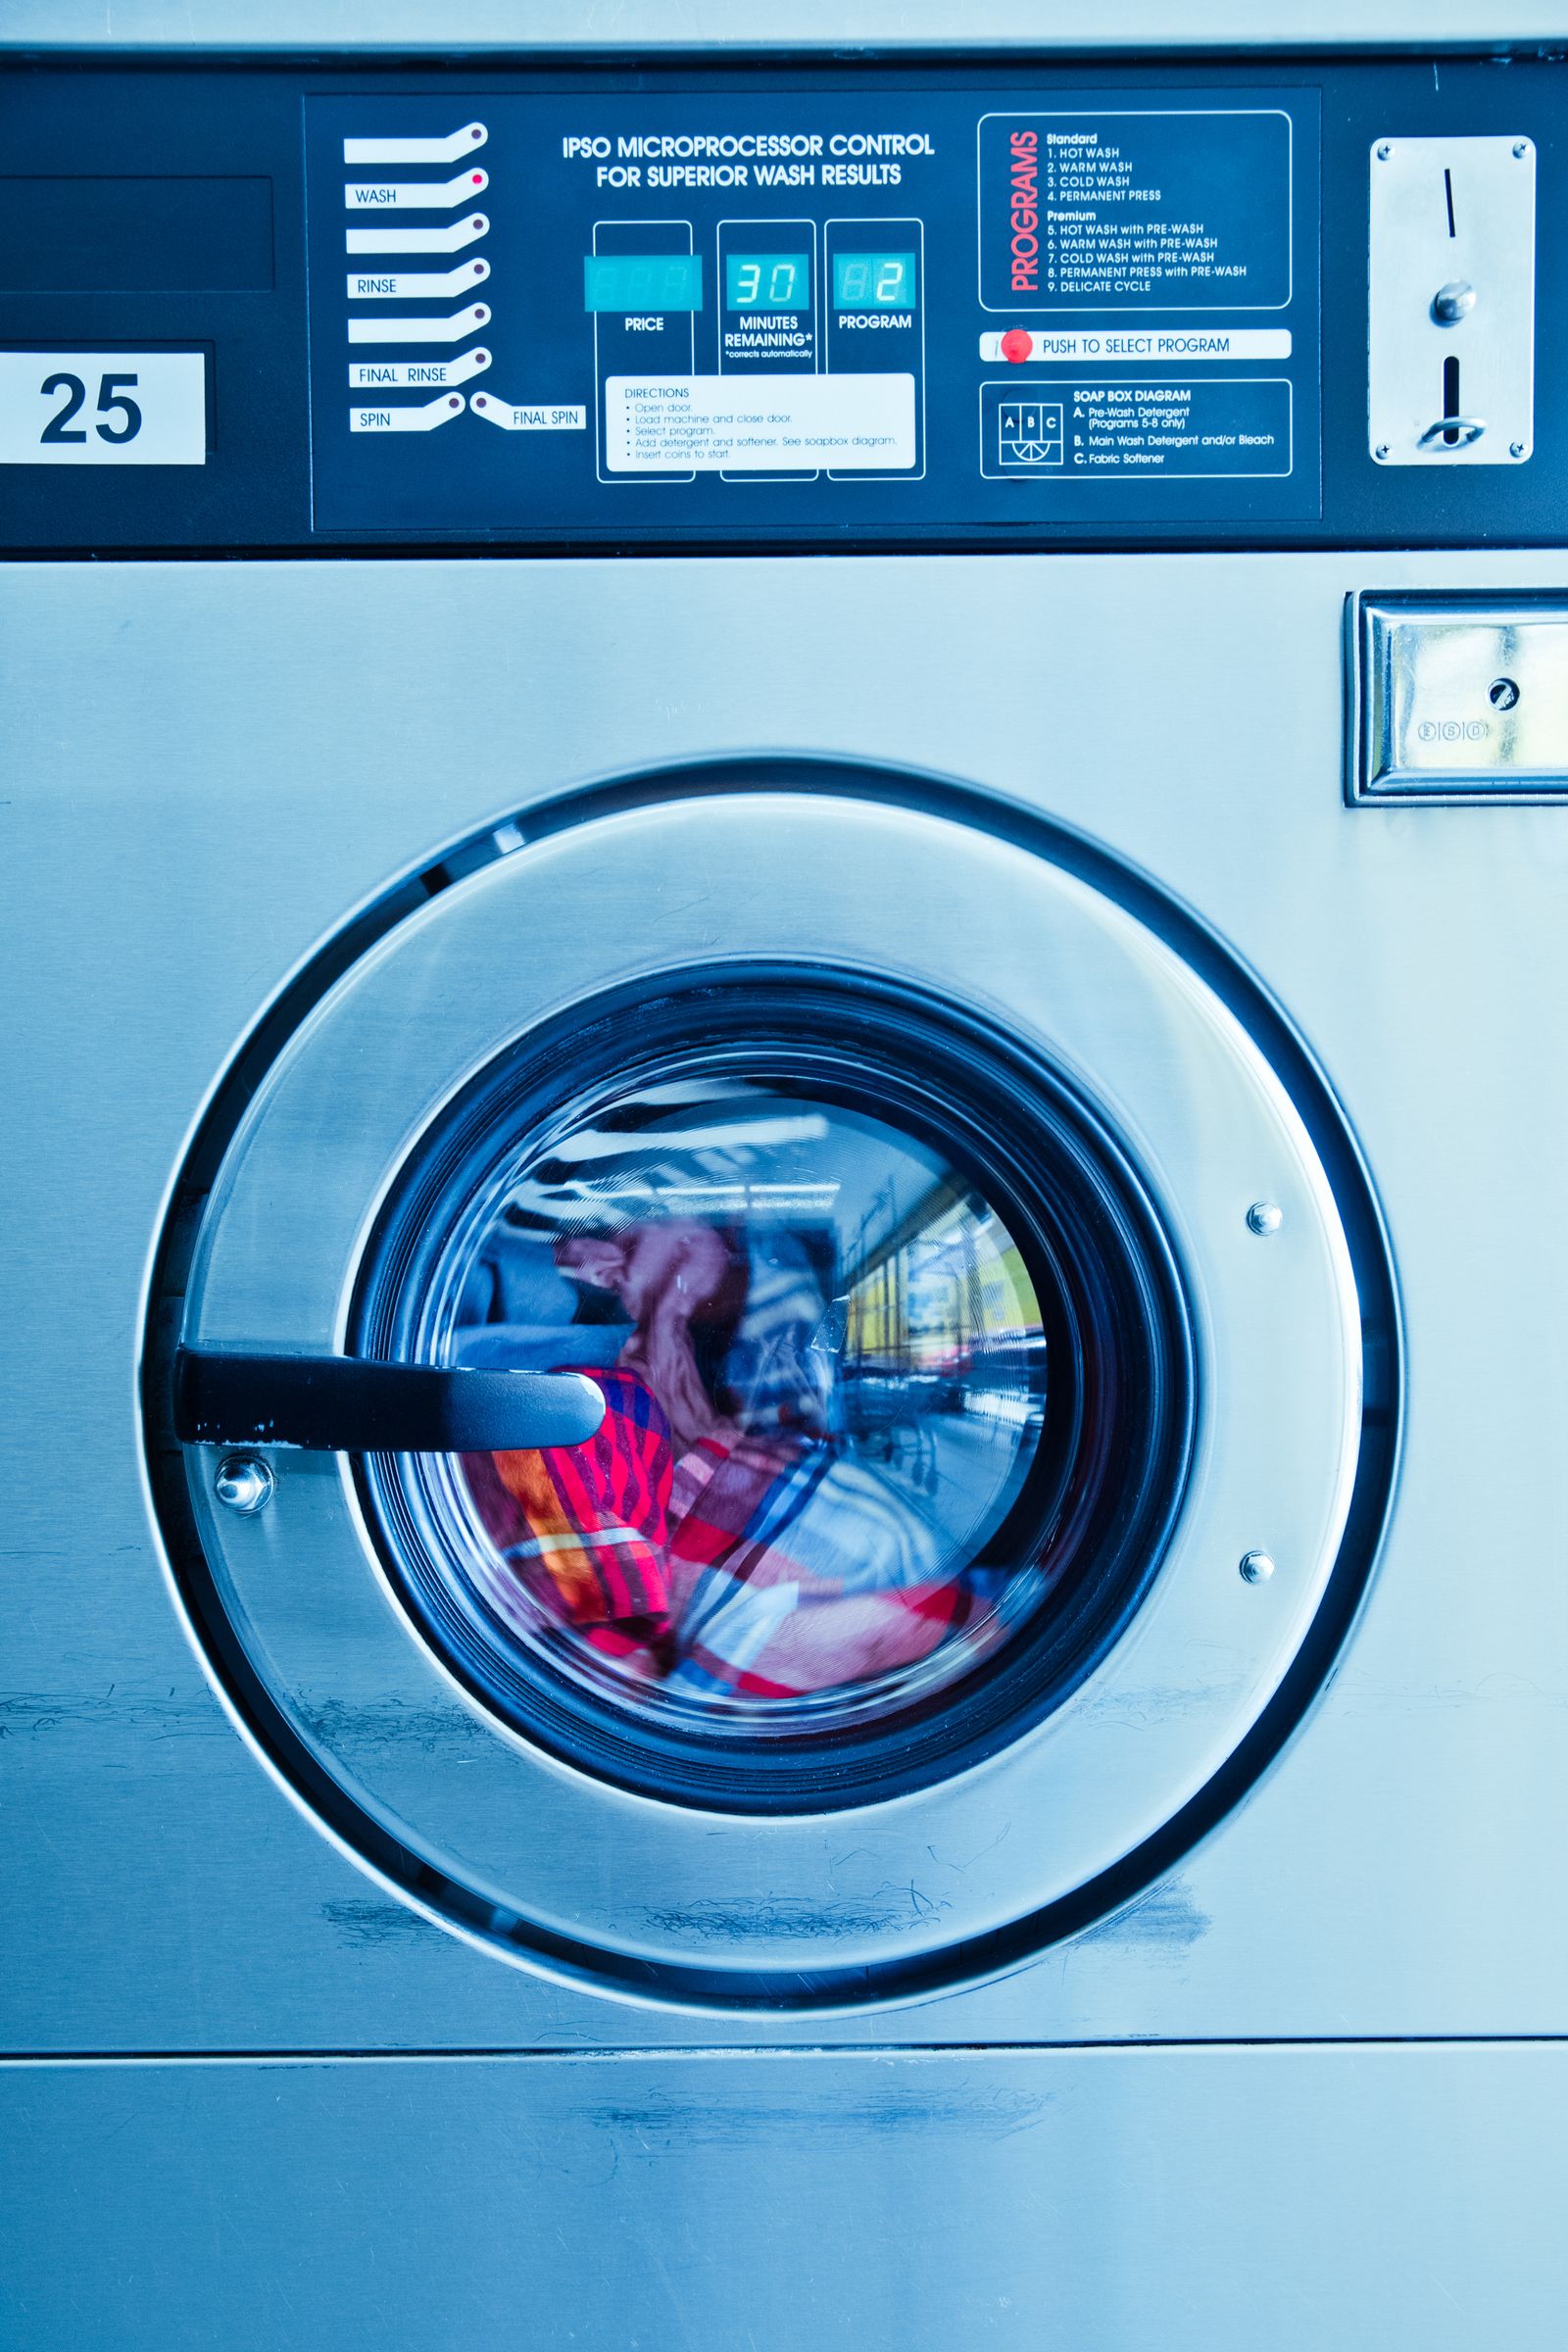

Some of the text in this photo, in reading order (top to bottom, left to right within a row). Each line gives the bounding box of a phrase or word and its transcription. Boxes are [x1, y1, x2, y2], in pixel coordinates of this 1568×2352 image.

[1047, 133, 1097, 144] Standard
[564, 134, 934, 158] IPSO MICROPROCESSOR CONTROL
[1048, 148, 1119, 158] 1. HOT WASH
[1048, 162, 1132, 172] 2. WARM WASH
[597, 164, 901, 187] FOR SUPERIOR WASH RESULTS
[1048, 176, 1129, 187] 3. COLD WASH
[355, 189, 396, 203] WASH
[1048, 190, 1160, 201] 4. PERMANENT PRESS
[1010, 131, 1038, 290] PROGRAMS
[1048, 211, 1096, 220] Premium
[1048, 224, 1203, 235] 5. HOT WASH with PRE-WASH
[1048, 238, 1217, 250] 6. WARM WASH with PRE-WASH
[1049, 253, 1214, 264] 7. COLD WASH with PRE-WASH
[1048, 267, 1247, 277] 8. PERMANENT PRESS with PRE-WASH
[359, 279, 396, 292] RINSE
[737, 264, 795, 303] 30
[1048, 281, 1151, 292] 9. DELICATE CYCLE
[625, 318, 663, 330] PRICE
[740, 317, 798, 329] MINUTES
[839, 316, 911, 328] PROGRAM
[1044, 338, 1229, 353] PUSH TO SELECT PROGRAM
[360, 368, 447, 381] FINAL RINSE
[625, 388, 689, 398] DIRECTIONS
[1074, 391, 1191, 402] SOAP BOX DIAGRAM
[40, 373, 141, 443] 25
[635, 404, 663, 413] Open
[1074, 408, 1190, 417] A. Pre-Wash Detergent
[361, 414, 390, 426] SPIN
[514, 411, 577, 424] FINAL SPIN
[635, 416, 661, 424] Load
[1005, 417, 1014, 427] A
[1028, 417, 1034, 427] B
[1047, 417, 1056, 428] C
[1089, 418, 1185, 429] (Programs 5-8 only)
[635, 426, 715, 436] Select program.
[661, 437, 710, 448] detergent
[737, 437, 778, 447] softener.
[782, 437, 802, 446] See
[805, 437, 848, 447] soapbox
[852, 437, 898, 447] diagram.
[1074, 435, 1274, 447] B. Main Wash Detergent and/or Bleach
[664, 450, 691, 459] coins
[709, 450, 730, 459] start.
[1074, 454, 1164, 464] C. Fabric Softener
